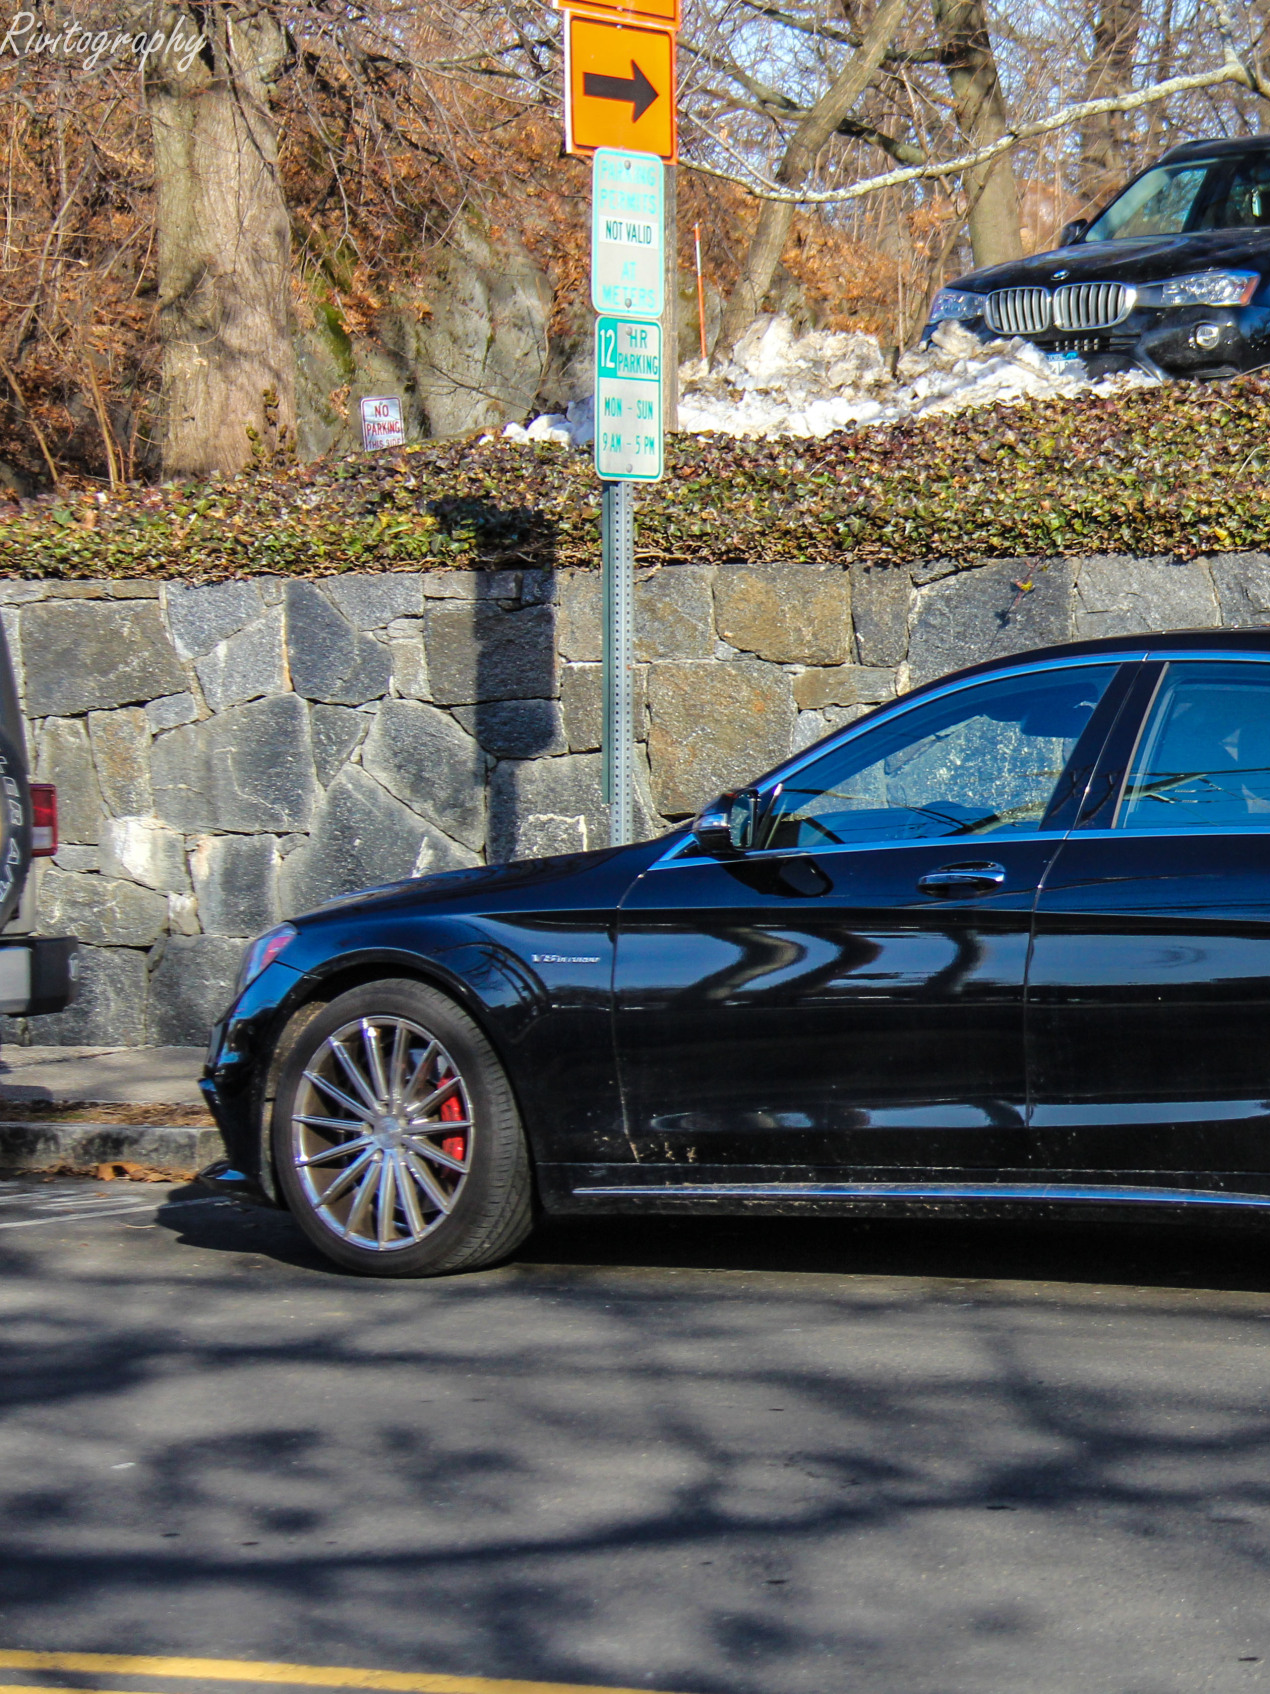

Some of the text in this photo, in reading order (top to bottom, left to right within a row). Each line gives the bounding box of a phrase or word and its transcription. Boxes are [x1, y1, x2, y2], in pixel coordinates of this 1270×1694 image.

[600, 159, 657, 187] PARKING
[600, 188, 657, 215] PERMITS
[605, 219, 652, 245] NOT VALID
[621, 261, 636, 281] AT
[601, 284, 656, 309] METERS
[600, 328, 648, 369] 12 HR
[617, 352, 659, 376] PARKING
[374, 404, 389, 418] NO
[604, 396, 622, 418] MON
[636, 399, 654, 421] SUN
[367, 421, 400, 436] PARKING
[602, 432, 608, 452] 9
[609, 432, 622, 453] AM
[635, 434, 641, 455] 5
[644, 435, 655, 456] PM
